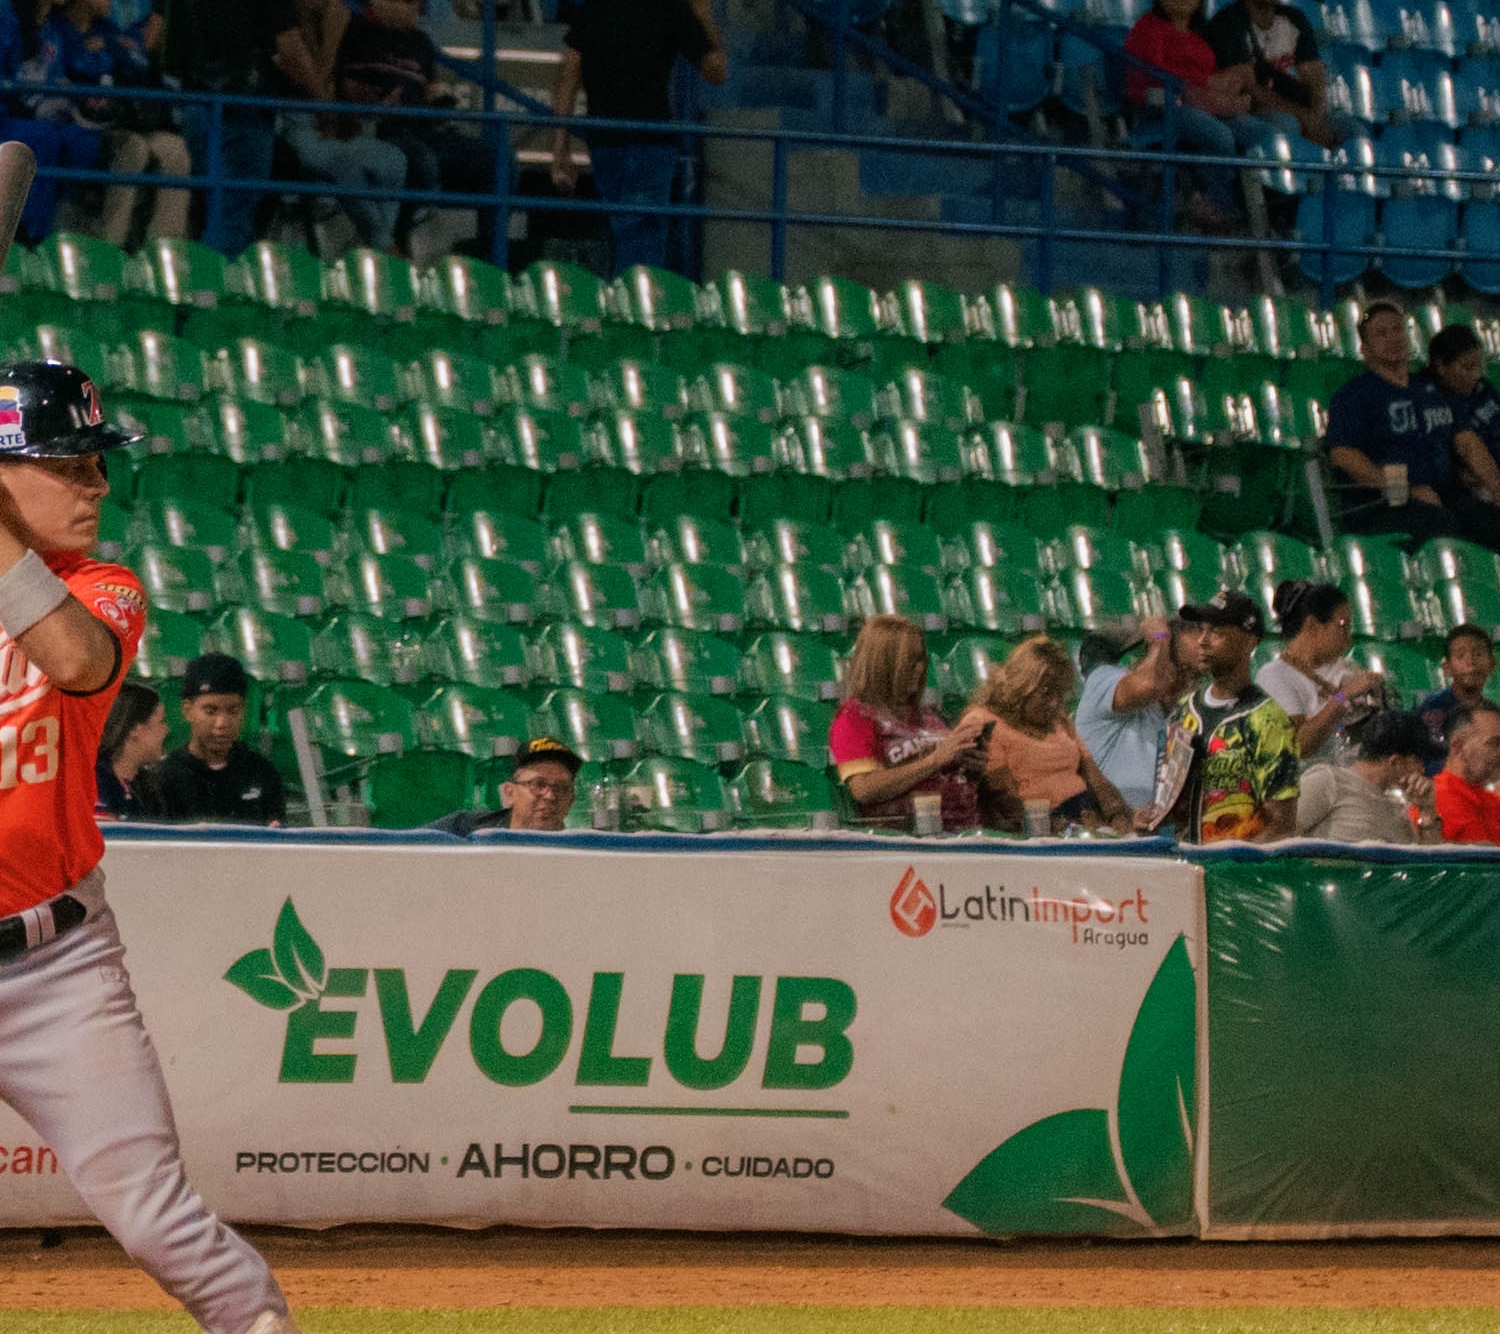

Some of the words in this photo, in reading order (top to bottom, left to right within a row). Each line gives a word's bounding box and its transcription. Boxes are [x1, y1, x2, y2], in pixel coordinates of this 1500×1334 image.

[1084, 928, 1149, 949] Aragua
[278, 967, 859, 1090] EVOLUB
[235, 1145, 430, 1174] PROTECCIÓN
[456, 1143, 676, 1181] AHORRO
[701, 1156, 835, 1180] CUIDADO
